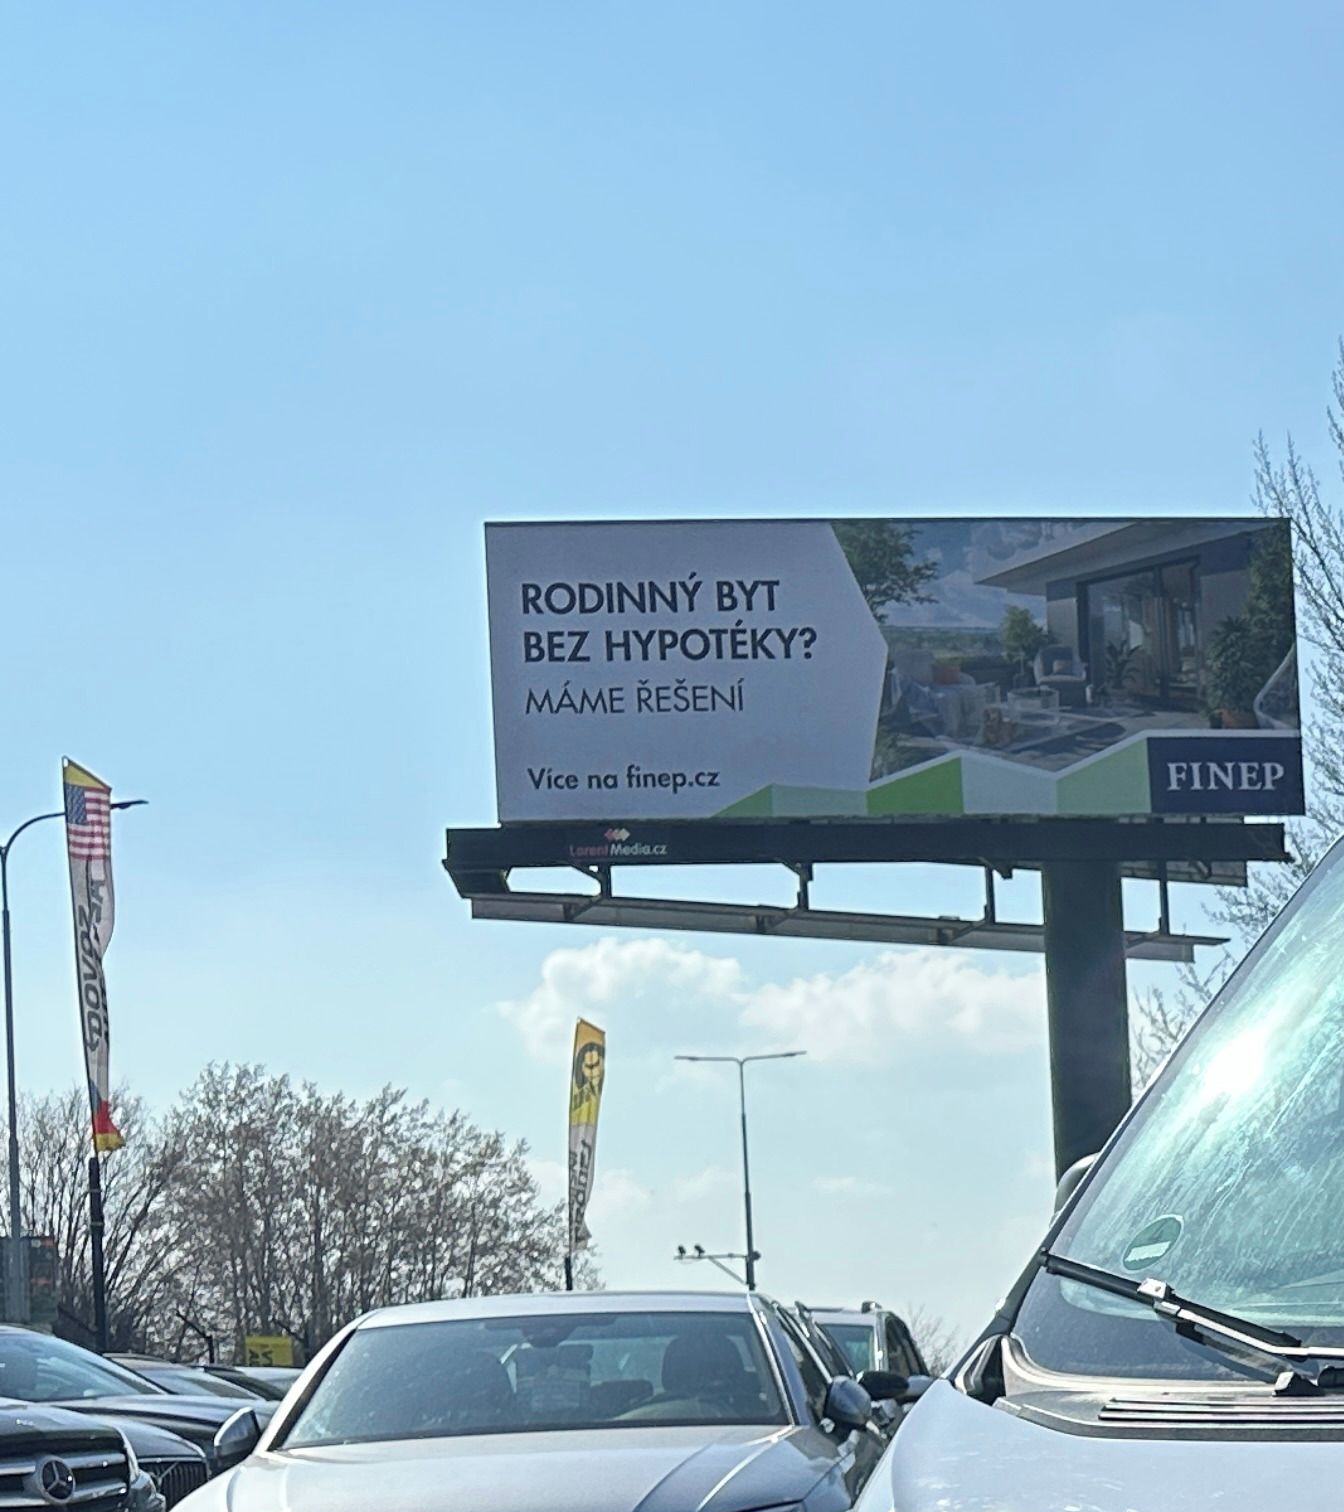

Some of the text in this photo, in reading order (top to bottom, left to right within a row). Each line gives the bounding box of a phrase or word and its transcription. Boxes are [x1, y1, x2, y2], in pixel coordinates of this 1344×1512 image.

[521, 572, 780, 615] RODINNÝ BYT
[524, 619, 818, 663] BEZ HYPOTÉKY?
[525, 678, 744, 714] MÁME ŘEŠENÍ
[528, 764, 720, 794] Více na finep.cz
[1167, 762, 1285, 790] FINEP
